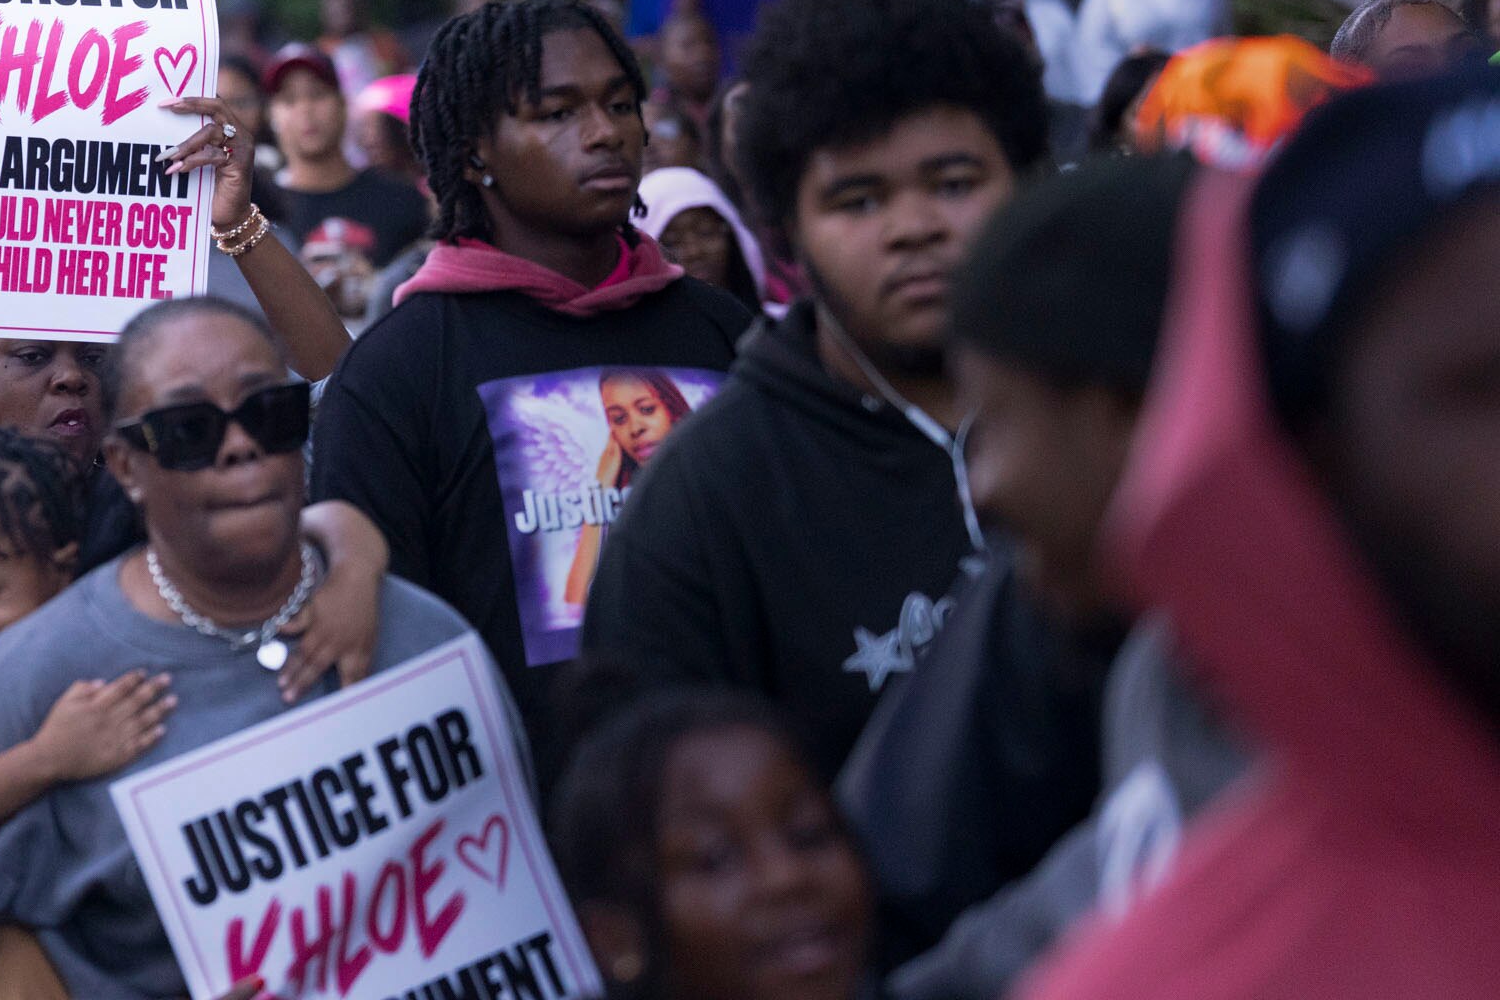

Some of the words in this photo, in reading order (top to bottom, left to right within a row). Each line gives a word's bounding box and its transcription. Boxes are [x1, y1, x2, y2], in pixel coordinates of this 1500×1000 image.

[43, 198, 124, 247] NEVER
[127, 203, 192, 251] COST
[57, 249, 110, 297] HER
[113, 252, 173, 300] LIFE.
[514, 484, 634, 534] Justic
[181, 751, 387, 905] JUSTICE
[377, 706, 485, 819] FOR
